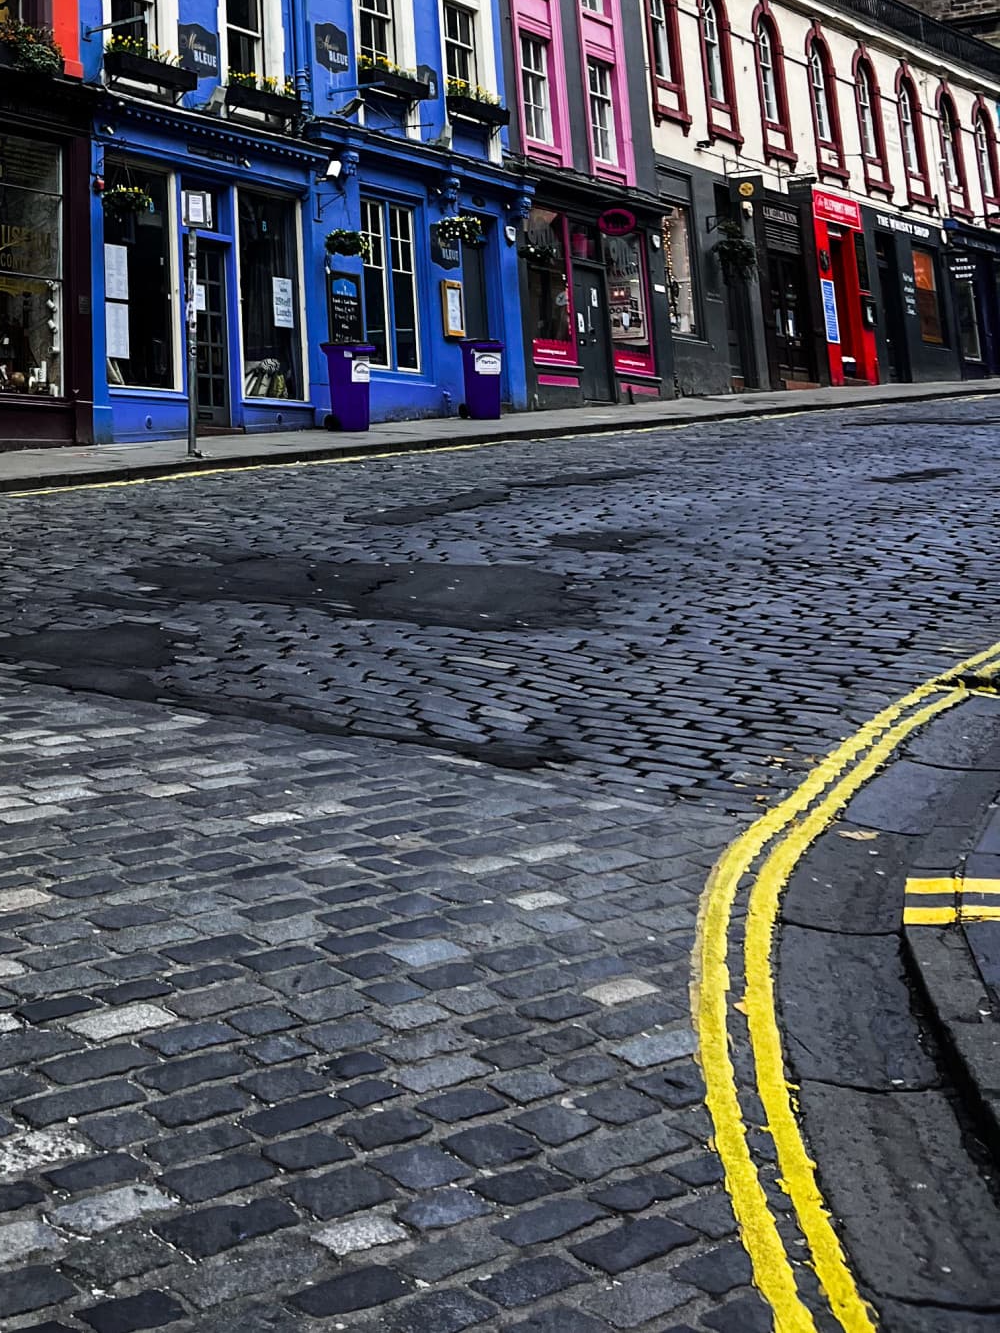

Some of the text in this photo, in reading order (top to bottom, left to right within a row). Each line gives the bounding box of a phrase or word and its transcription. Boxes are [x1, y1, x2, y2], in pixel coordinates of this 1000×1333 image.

[194, 50, 217, 68] BLEUE
[328, 51, 349, 67] BLEUE
[876, 214, 889, 227] THE
